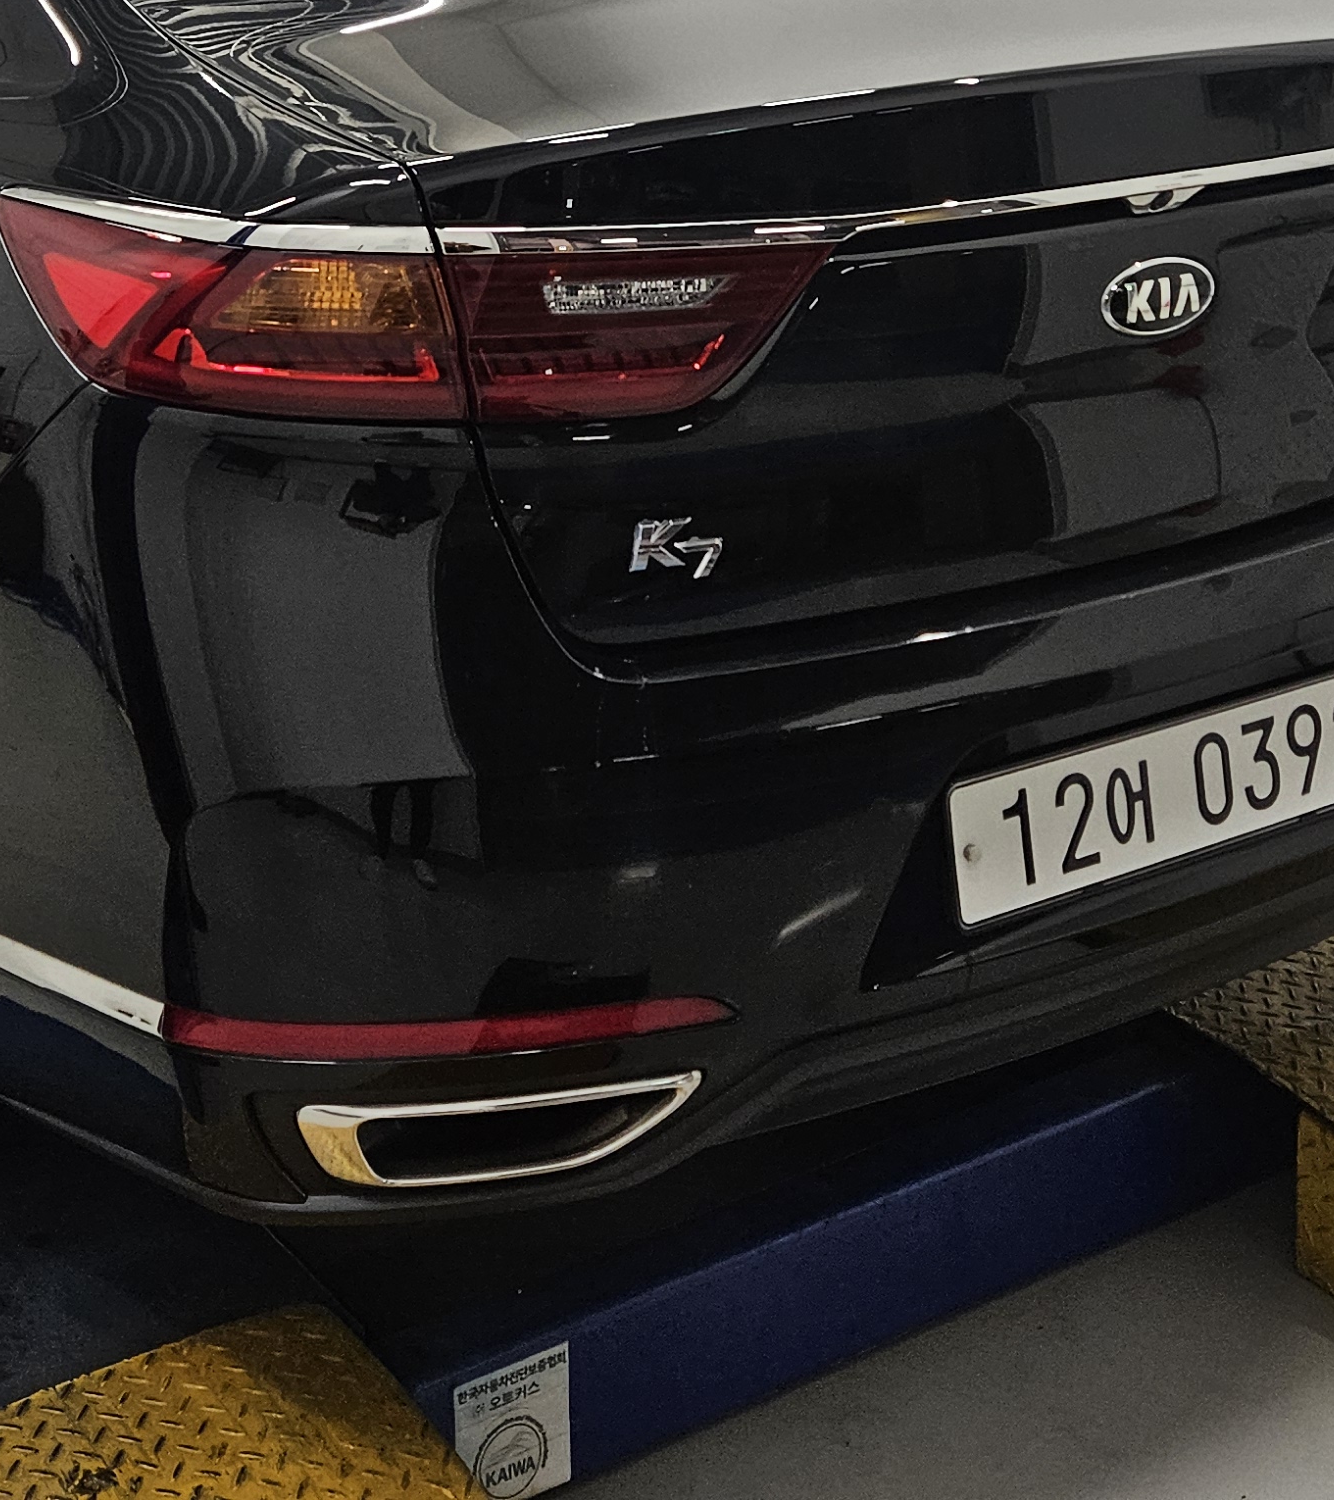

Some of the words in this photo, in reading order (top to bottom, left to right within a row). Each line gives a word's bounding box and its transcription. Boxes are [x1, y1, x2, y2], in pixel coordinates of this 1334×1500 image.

[1124, 272, 1201, 325] KIA
[628, 516, 723, 579] K7
[1002, 759, 1155, 886] 12어
[485, 1456, 536, 1488] KAIWA
